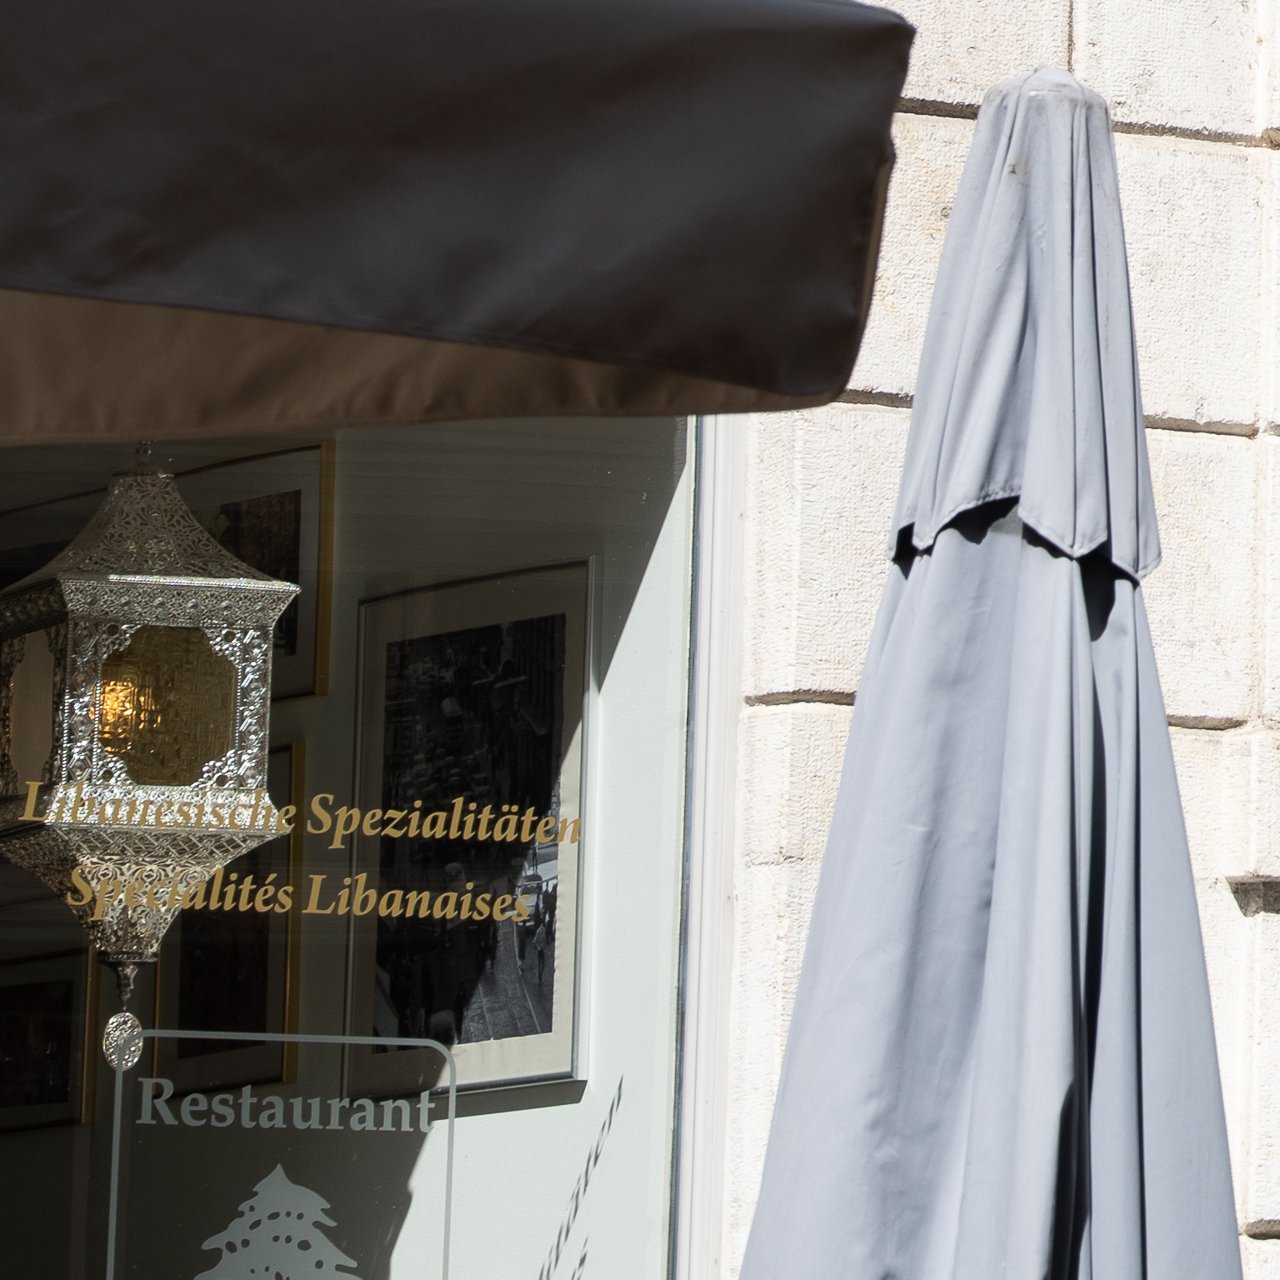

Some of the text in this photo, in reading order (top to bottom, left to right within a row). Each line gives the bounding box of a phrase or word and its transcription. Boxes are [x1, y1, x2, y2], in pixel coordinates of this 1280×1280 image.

[306, 793, 583, 850] Spezialitäten
[67, 864, 532, 922] Spécialités Libanaises
[135, 1077, 436, 1133] Restaurant
